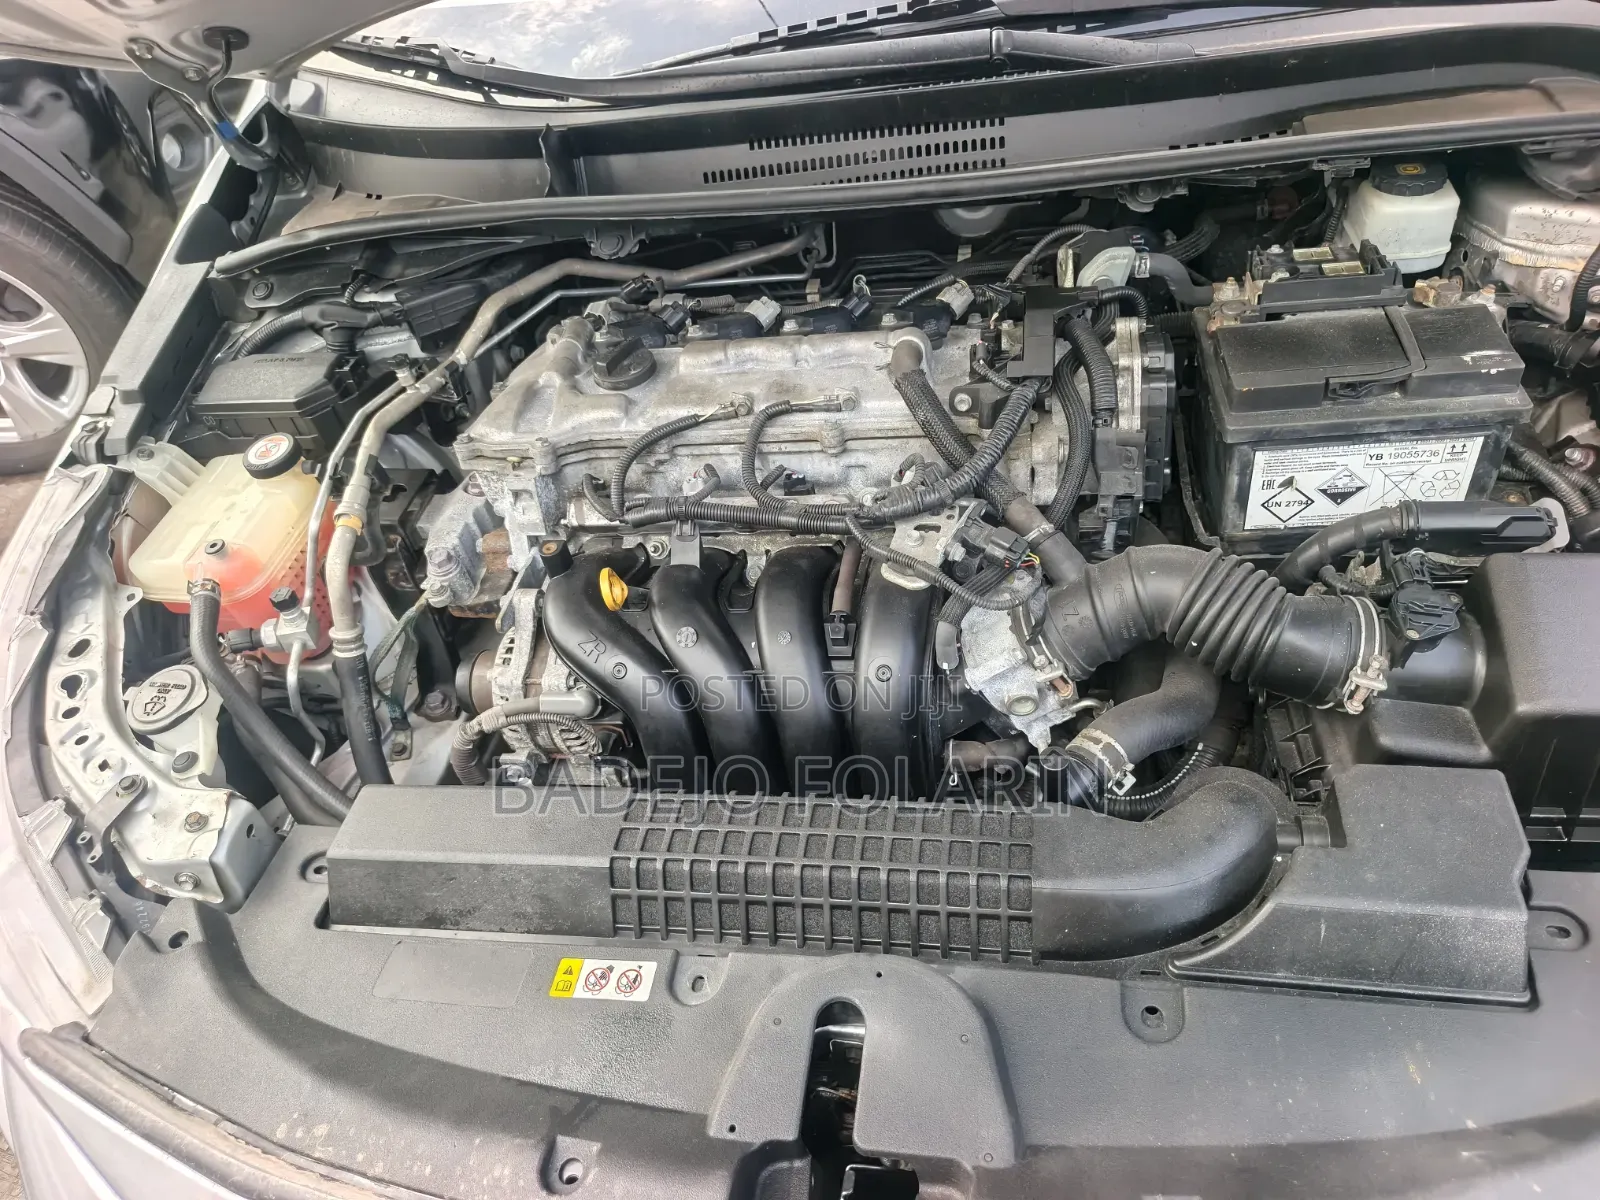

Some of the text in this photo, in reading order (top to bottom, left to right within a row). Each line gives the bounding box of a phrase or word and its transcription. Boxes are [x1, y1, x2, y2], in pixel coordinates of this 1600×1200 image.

[1368, 453, 1384, 461] YB
[1387, 449, 1441, 460] 19055736
[1261, 479, 1277, 491] EAC
[1266, 499, 1310, 508] UN 2794
[577, 629, 607, 664] ZR
